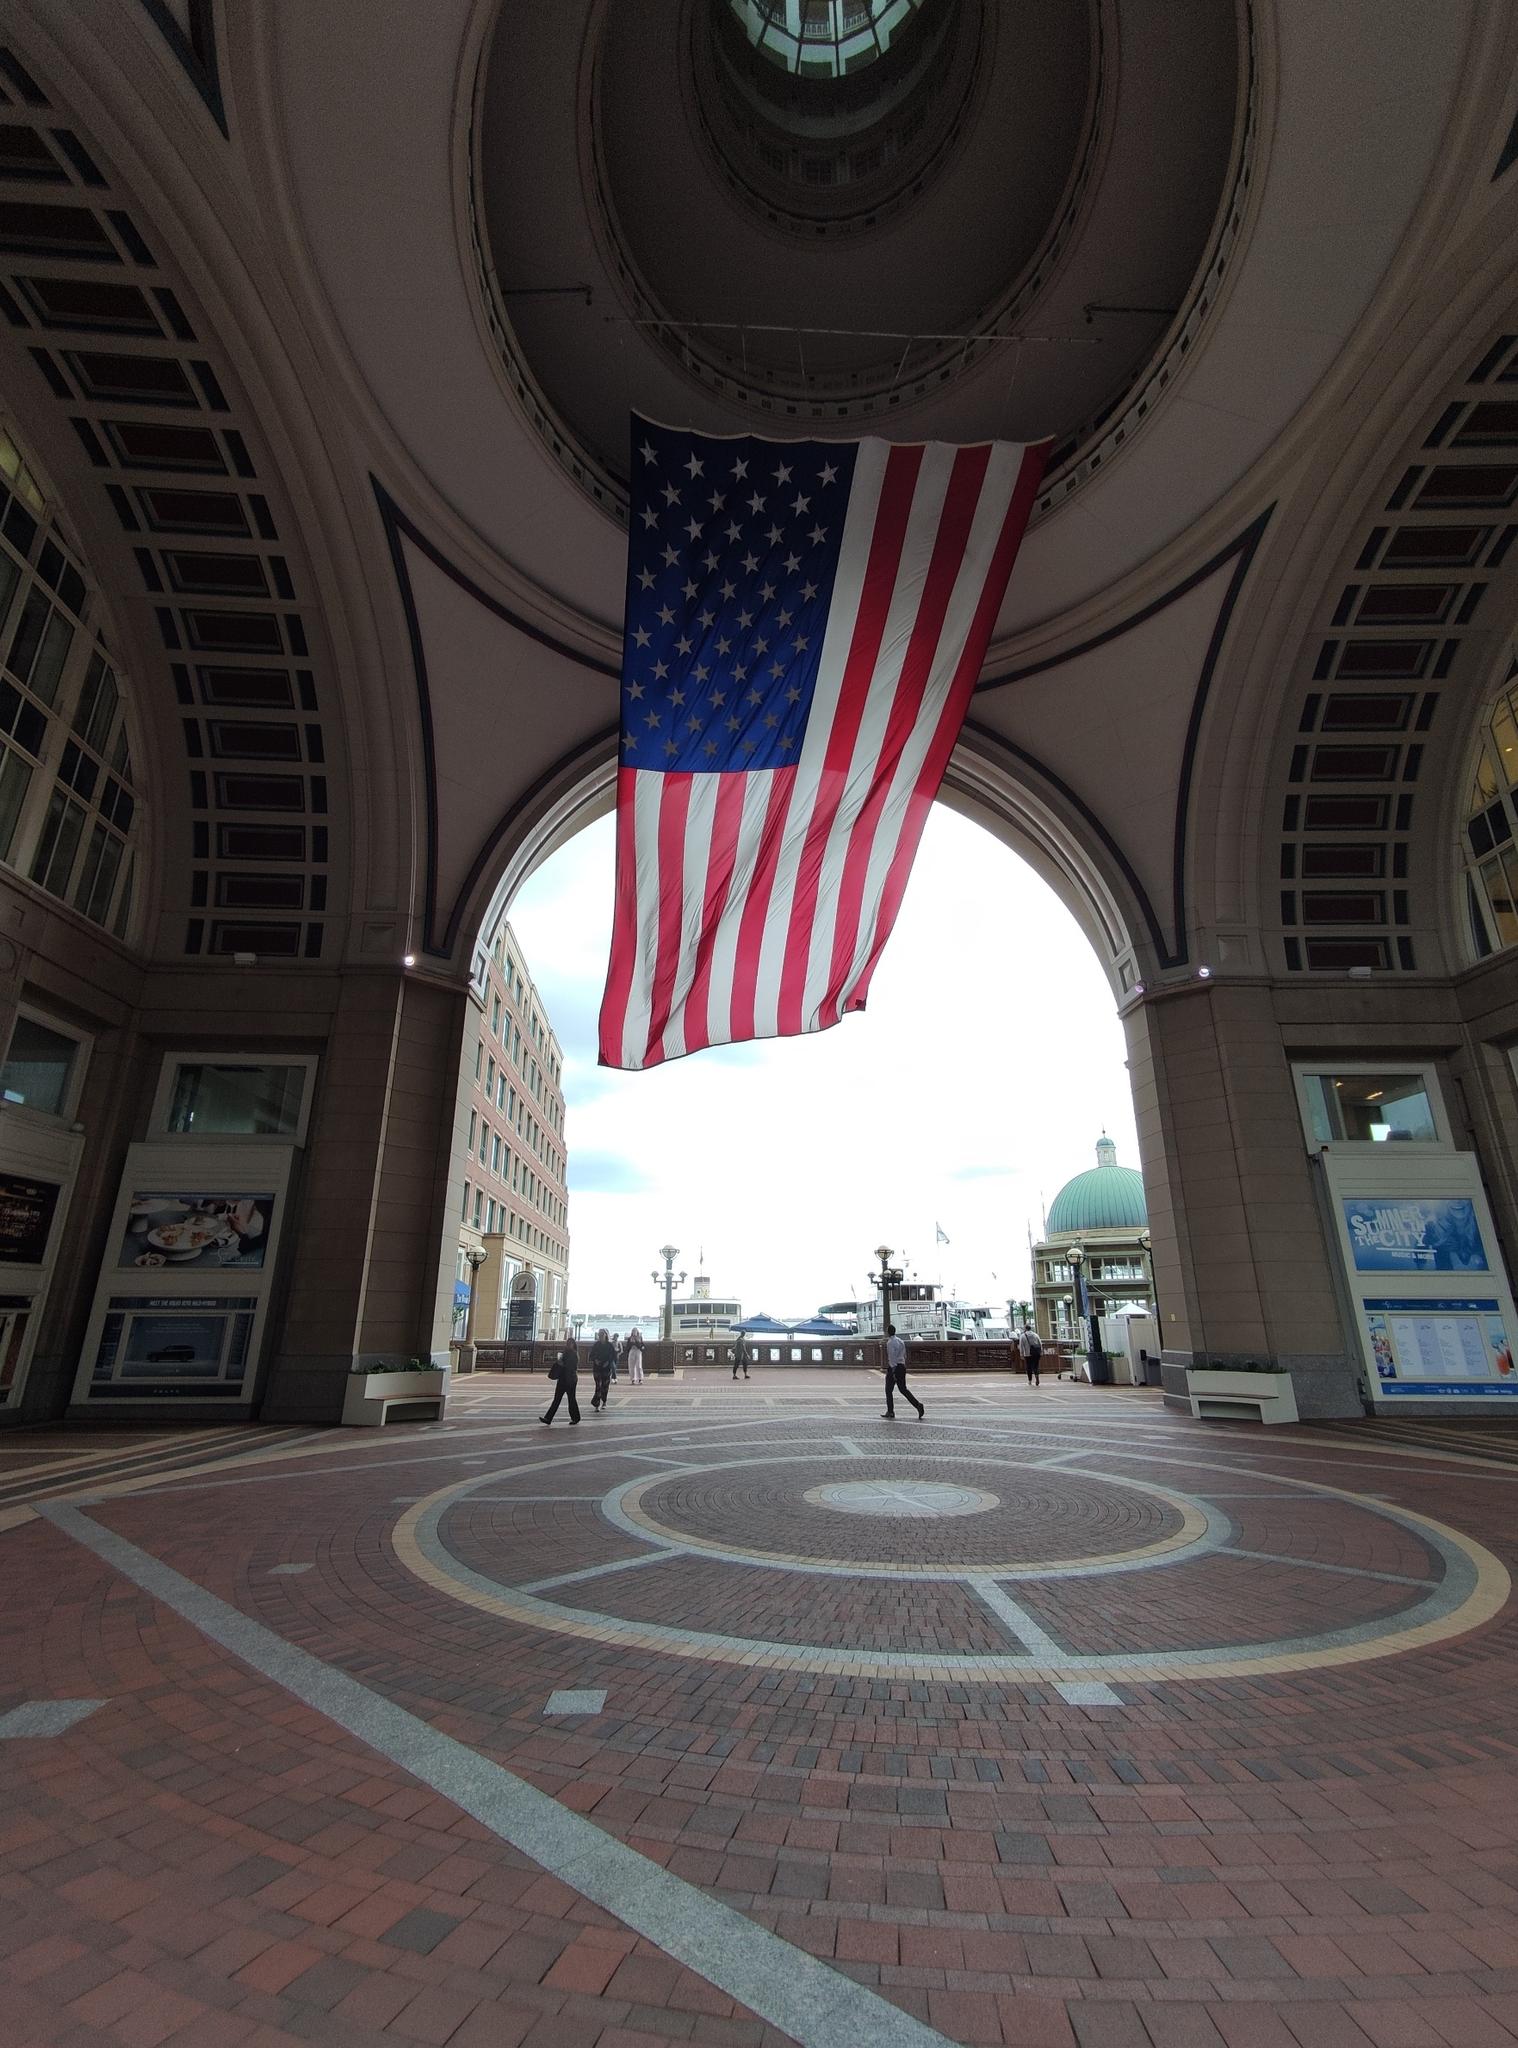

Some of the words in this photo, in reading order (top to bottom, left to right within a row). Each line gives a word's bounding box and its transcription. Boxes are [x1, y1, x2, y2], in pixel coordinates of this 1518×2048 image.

[1351, 1206, 1424, 1235] SUMMER
[1355, 1233, 1380, 1246] THE
[1379, 1230, 1427, 1247] CITY
